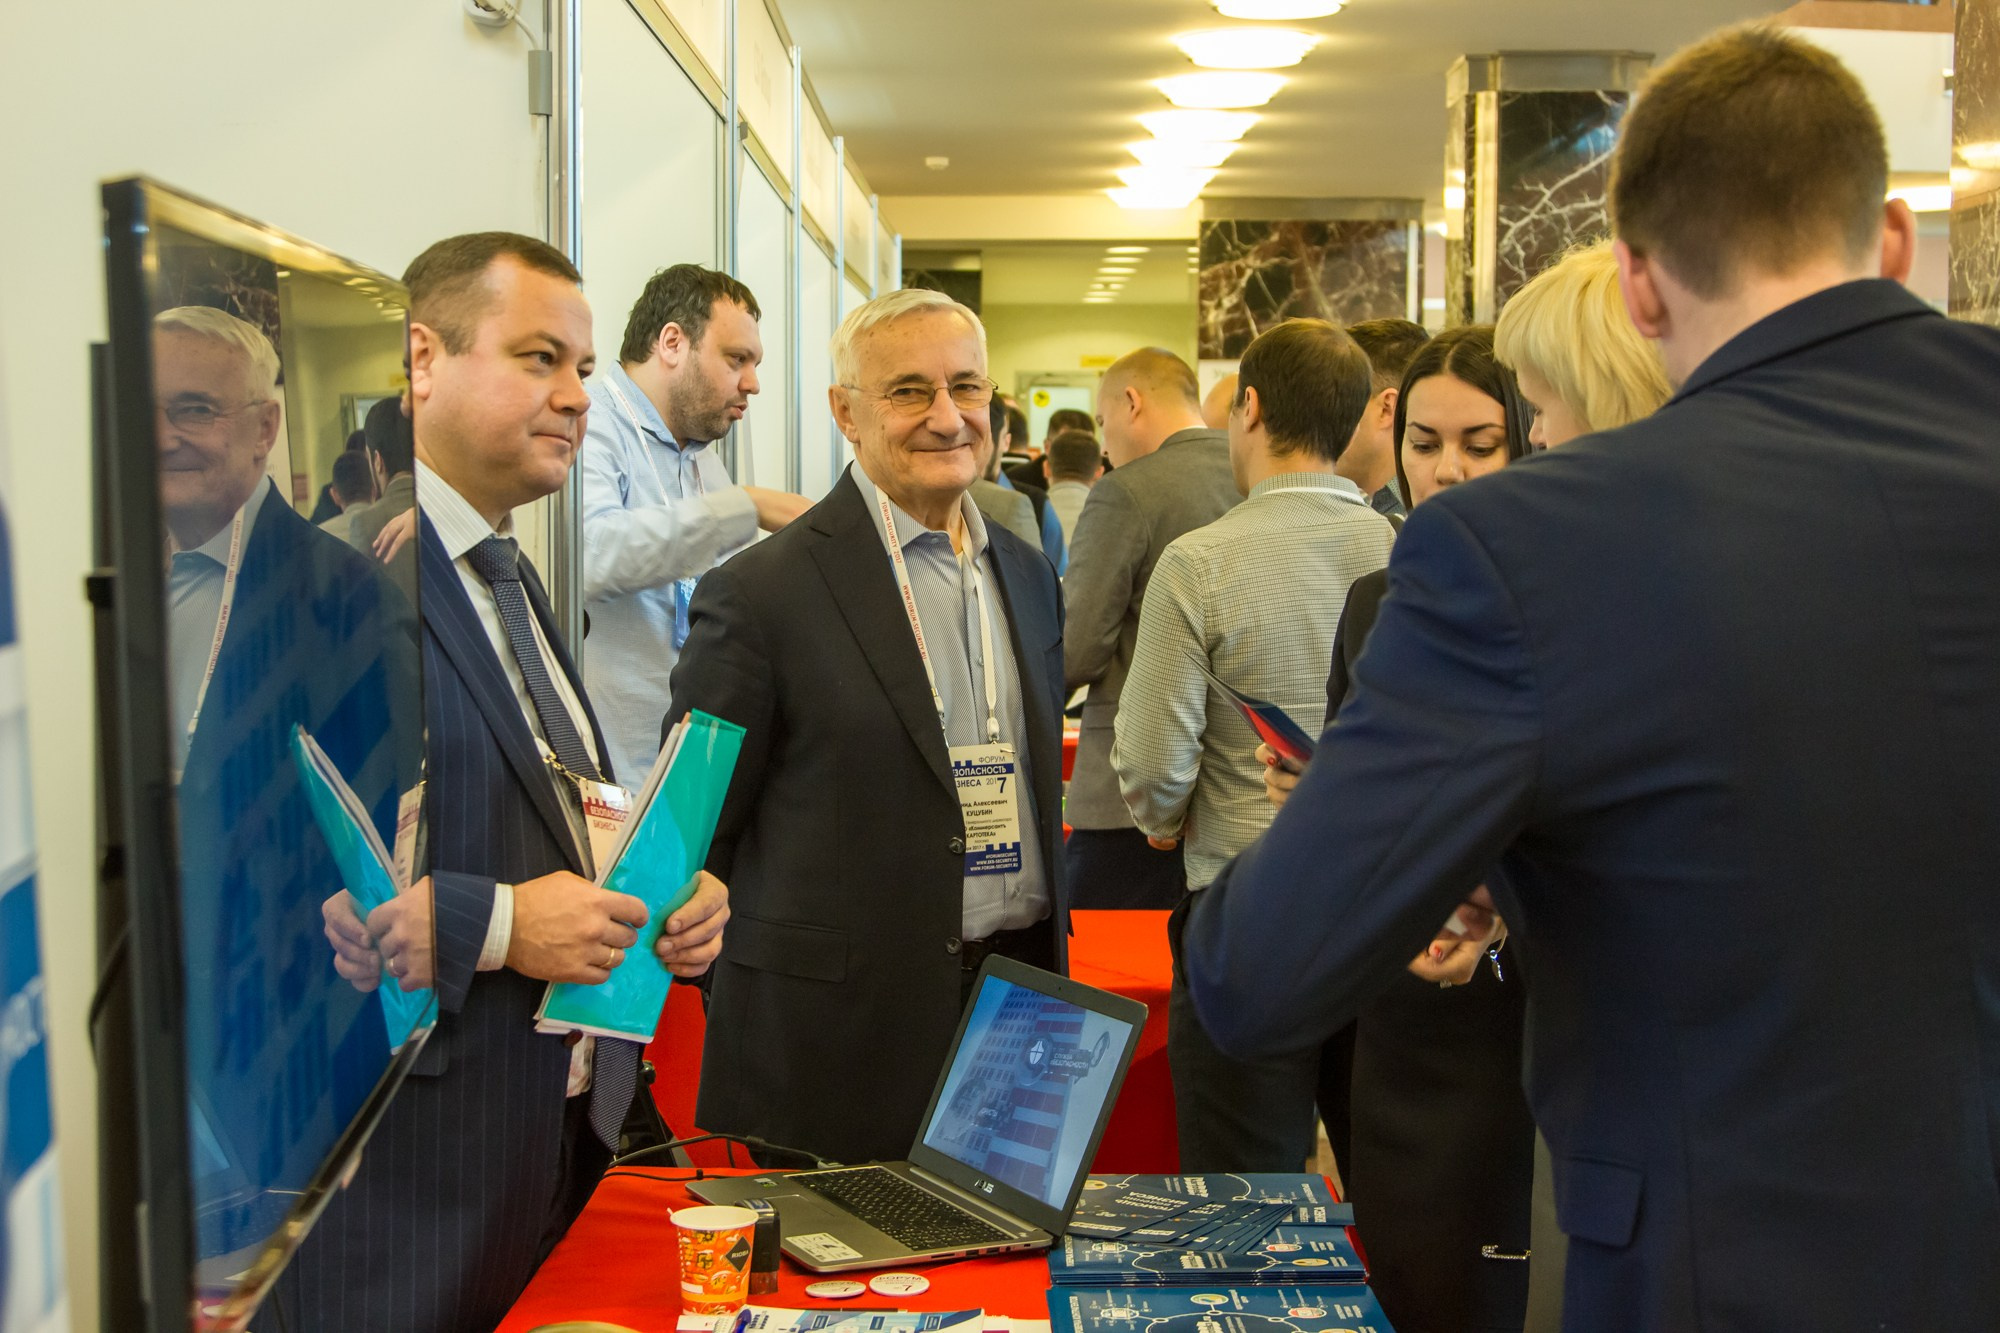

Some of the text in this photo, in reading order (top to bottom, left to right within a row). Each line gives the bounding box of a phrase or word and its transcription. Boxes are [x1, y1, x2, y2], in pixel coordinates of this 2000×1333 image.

[881, 501, 902, 564] FORUM SECURITY 2017
[978, 755, 1006, 764] ФОРУМ
[953, 765, 1007, 777] ЗОПАСНОСТЬ
[956, 778, 982, 788] ЗНЕСА
[973, 799, 1008, 808] Алексеевич
